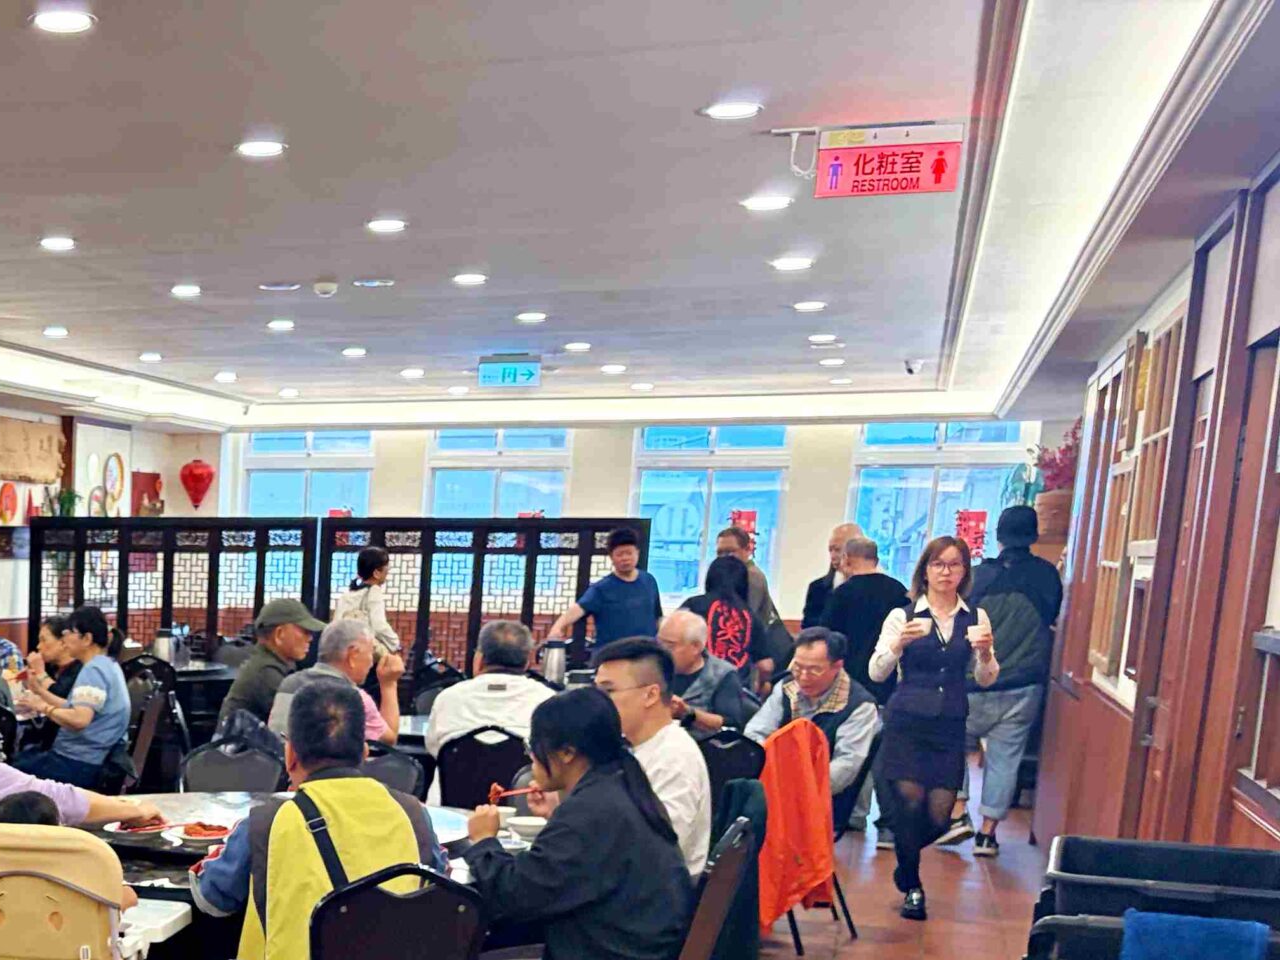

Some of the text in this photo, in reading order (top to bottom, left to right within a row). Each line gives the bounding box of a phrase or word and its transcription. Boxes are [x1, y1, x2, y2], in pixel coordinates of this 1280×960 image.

[853, 150, 924, 176] 化粧室
[851, 177, 921, 193] RESTROOM
